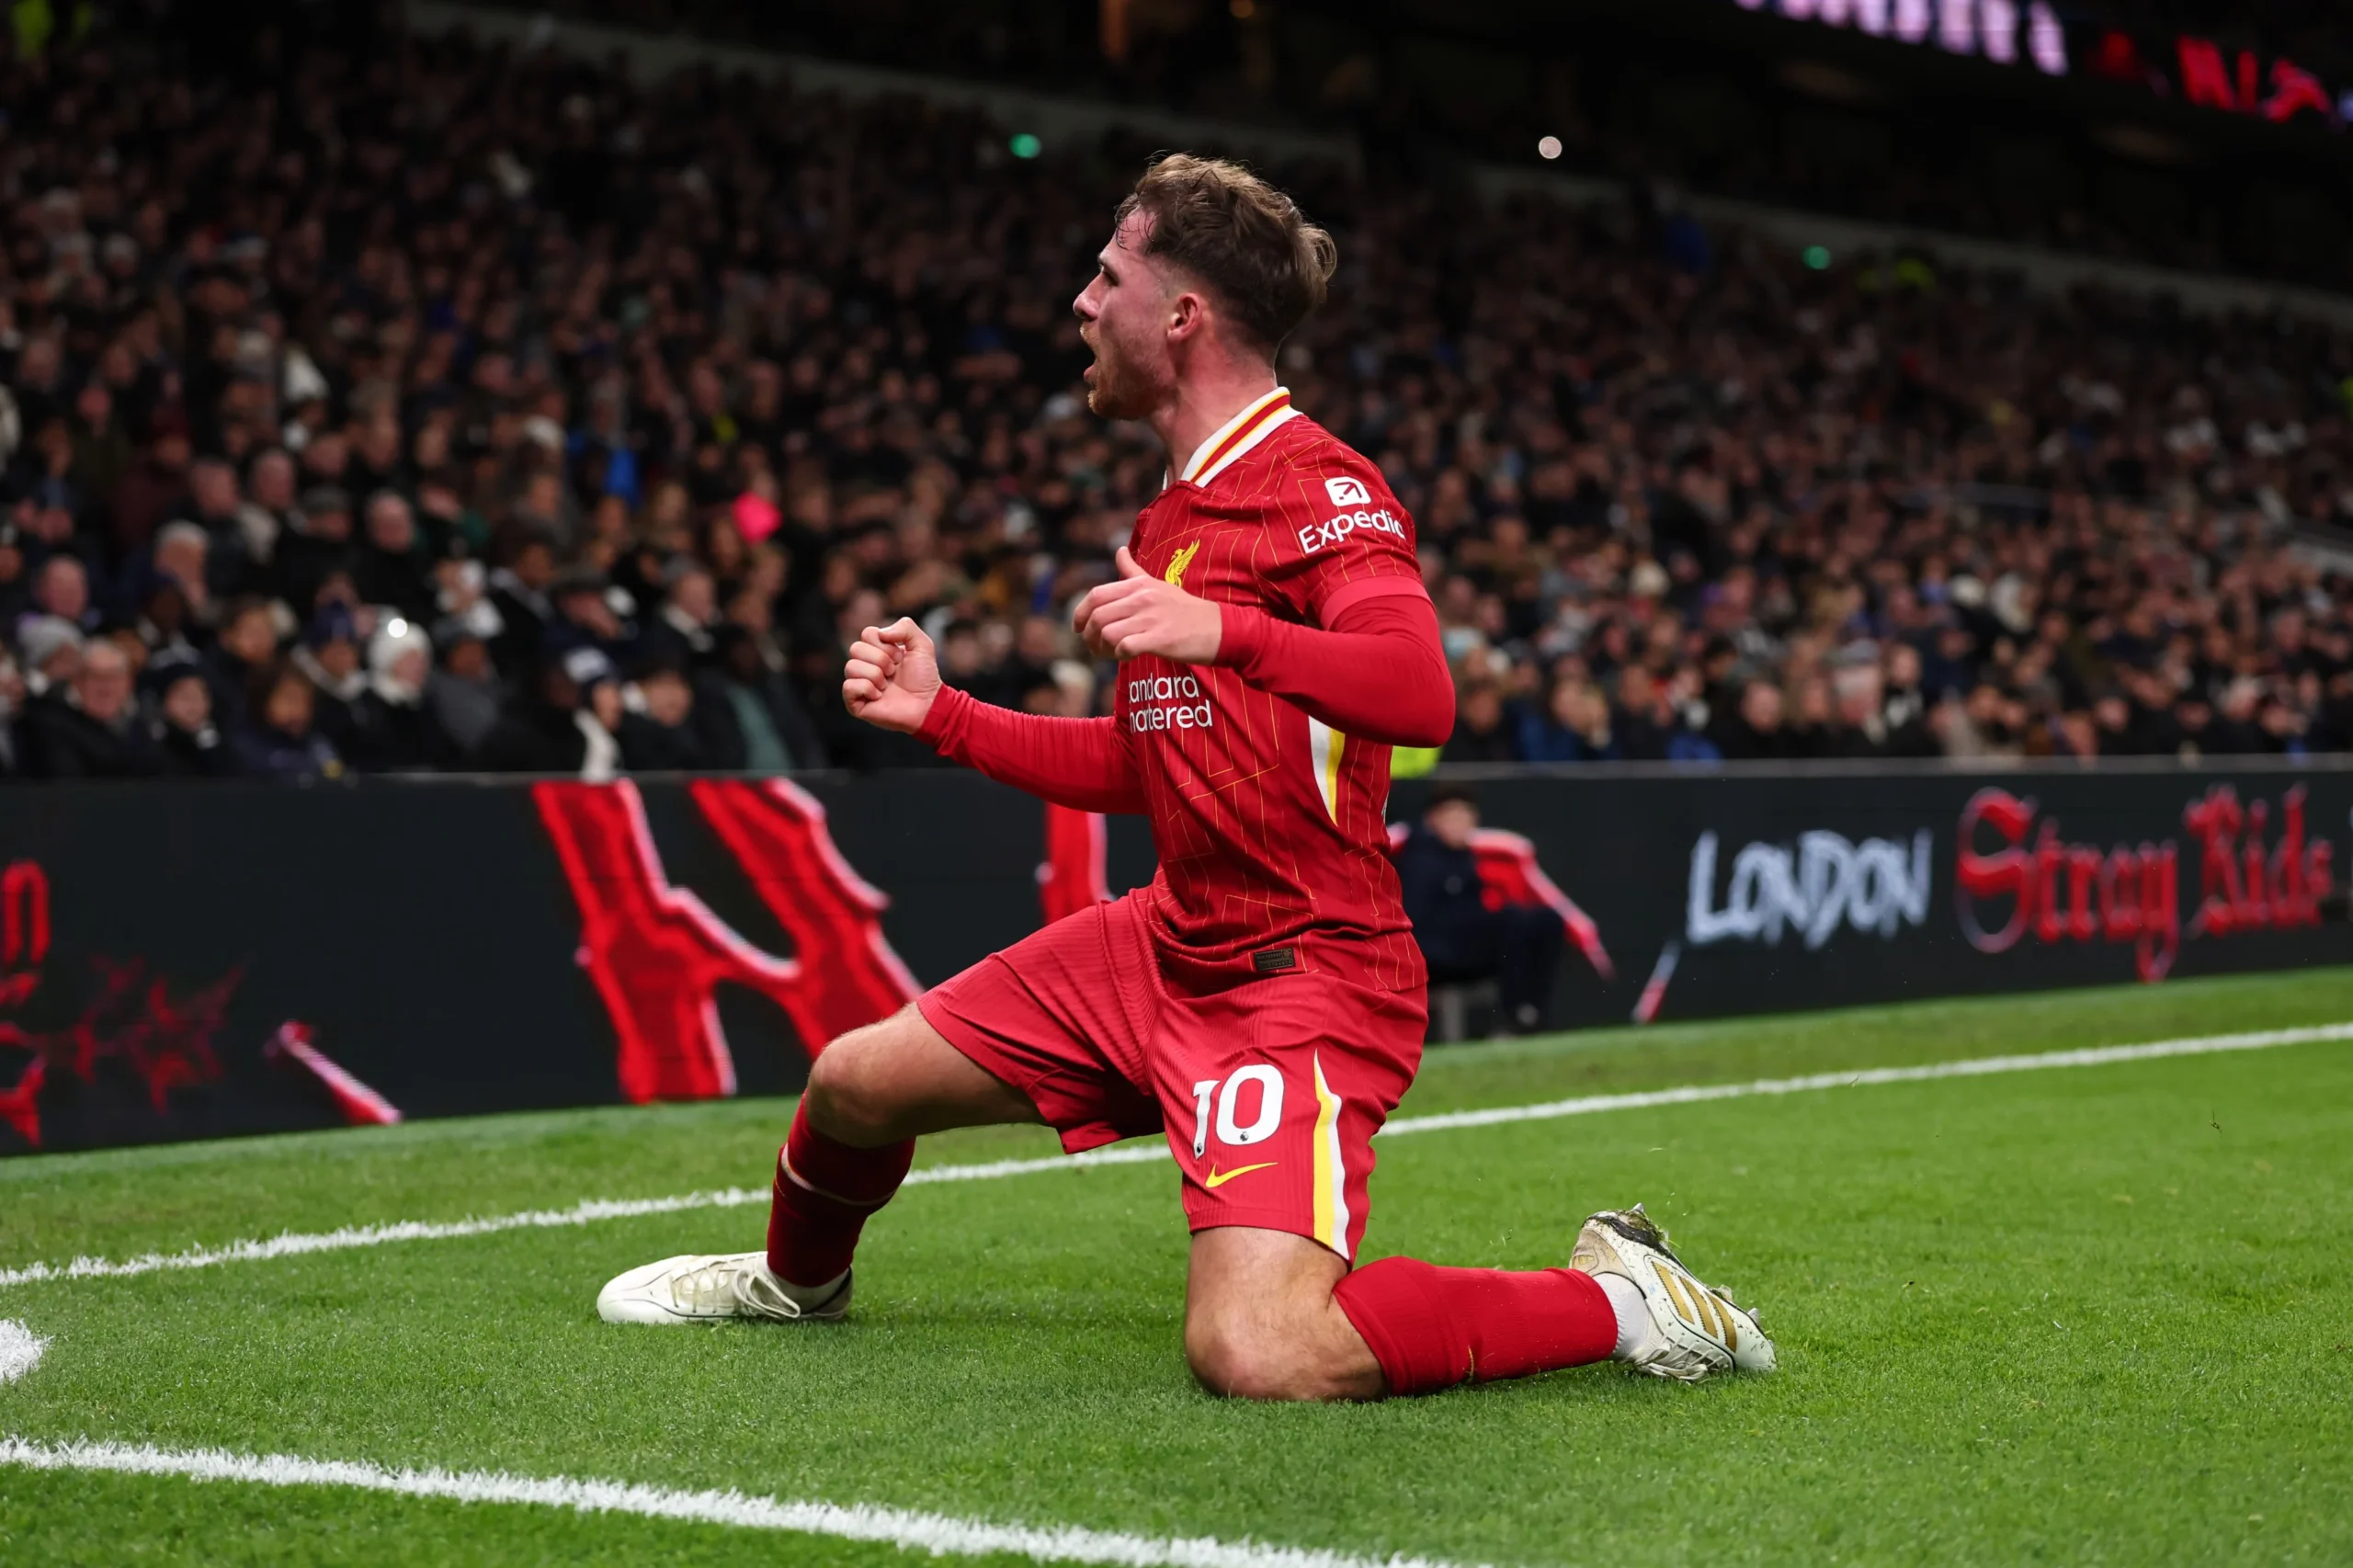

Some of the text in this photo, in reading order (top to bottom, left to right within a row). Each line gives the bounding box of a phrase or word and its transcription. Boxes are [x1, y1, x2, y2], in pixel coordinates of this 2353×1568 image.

[1129, 672, 1199, 704] andard
[1686, 827, 1932, 950] LONDON
[1954, 782, 2335, 982] Stray Kids
[1192, 1063, 1285, 1160] 10
